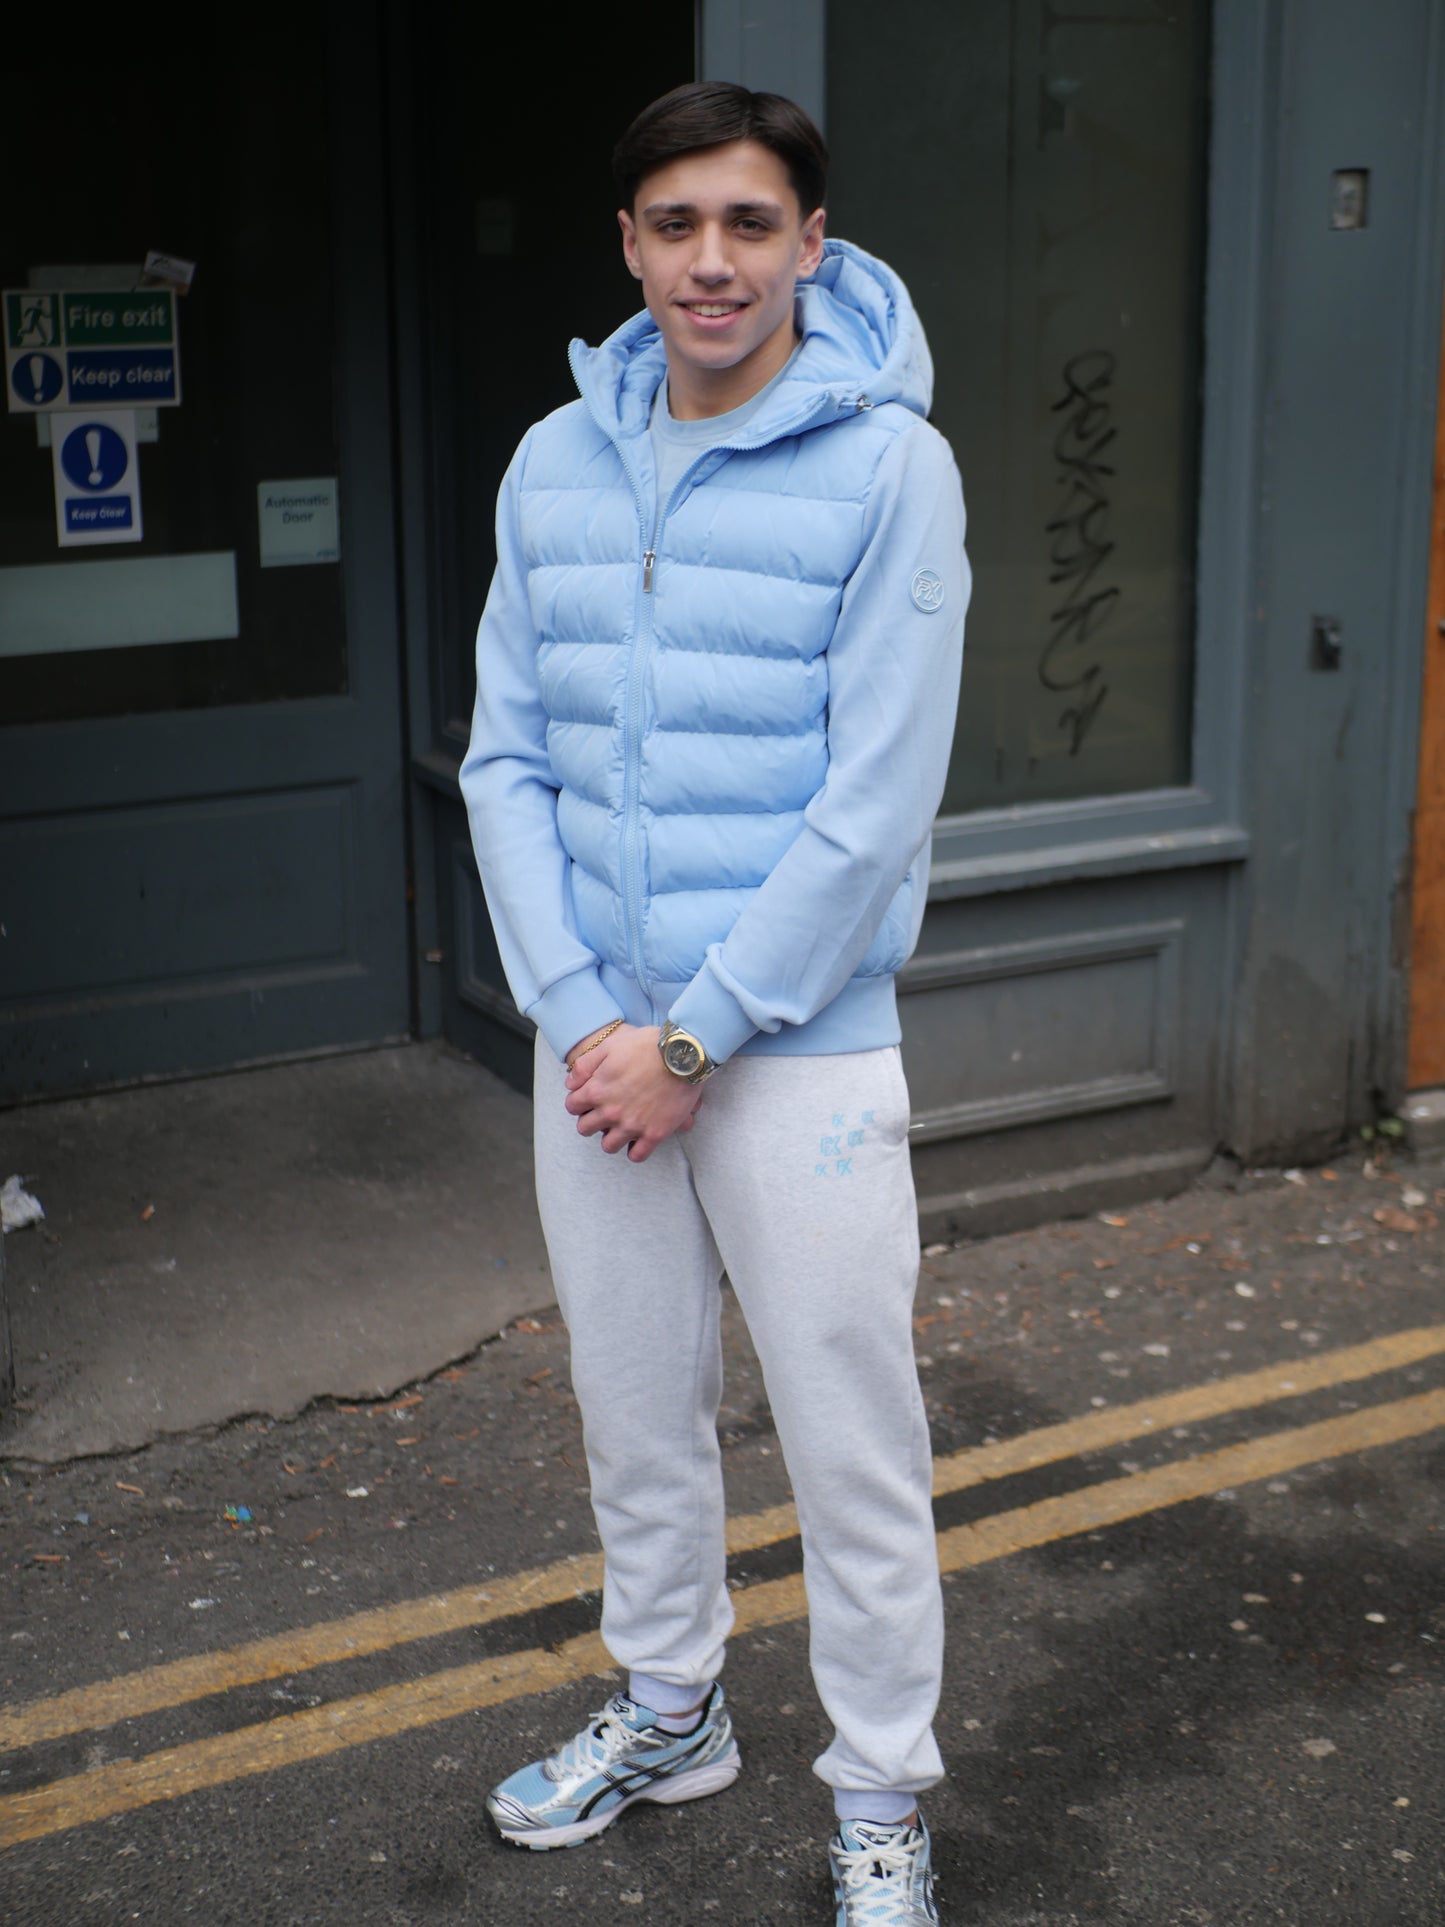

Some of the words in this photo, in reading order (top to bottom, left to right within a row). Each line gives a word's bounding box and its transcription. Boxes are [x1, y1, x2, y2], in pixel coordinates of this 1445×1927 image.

[68, 304, 115, 329] Fire
[121, 303, 166, 327] exit
[71, 364, 121, 388] Keep
[126, 362, 172, 384] clear
[265, 495, 329, 509] Automatic
[71, 506, 98, 521] Keep
[98, 504, 127, 519] Clear
[282, 511, 314, 525] Door
